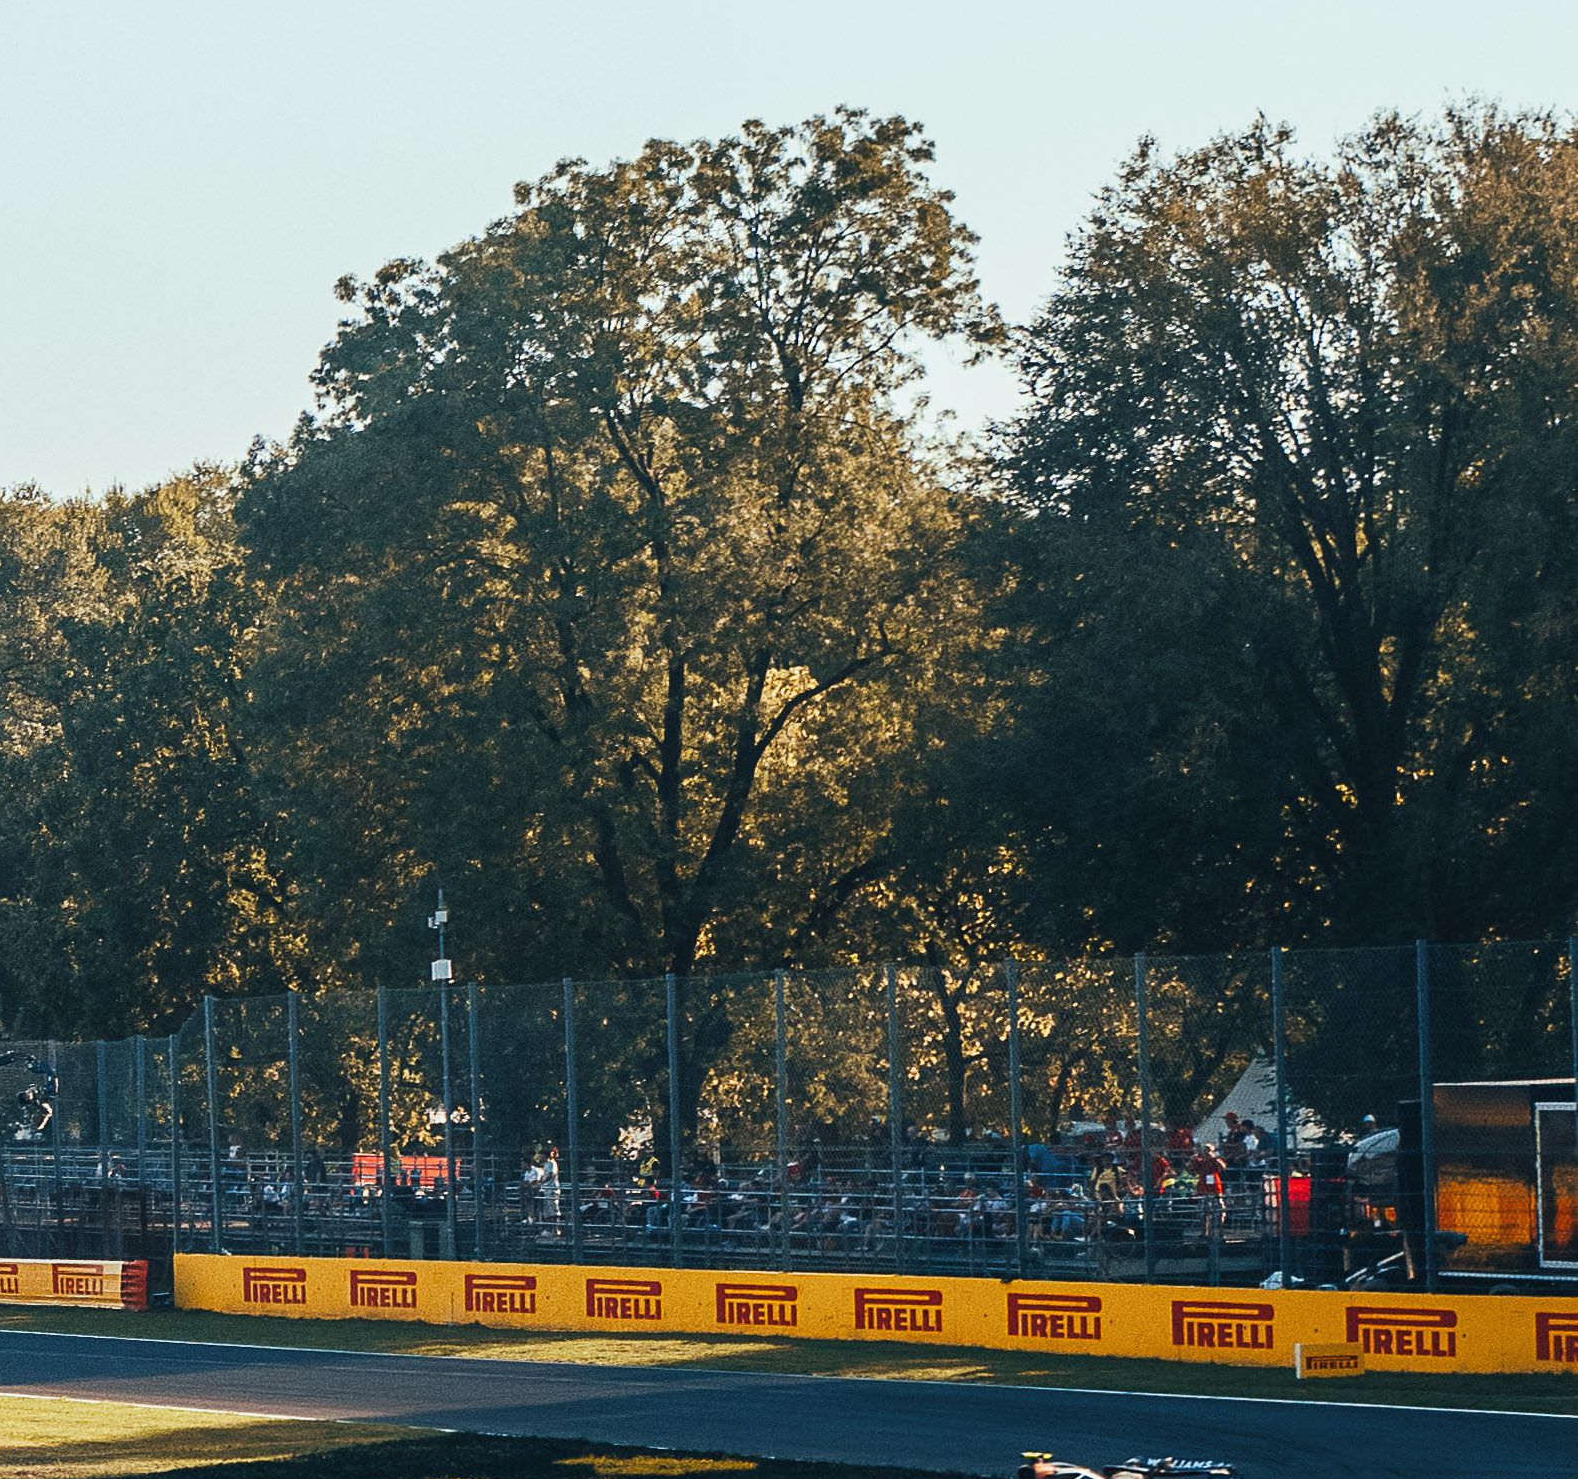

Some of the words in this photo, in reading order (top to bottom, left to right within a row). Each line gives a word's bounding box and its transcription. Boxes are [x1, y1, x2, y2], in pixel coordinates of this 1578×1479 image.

[52, 1264, 103, 1296] PIRELLI
[243, 1268, 306, 1304] PIRELLI
[350, 1270, 417, 1308] PIRELLI
[465, 1274, 536, 1314] PIRELLI
[586, 1279, 662, 1320] PIRELLI
[716, 1284, 797, 1326] PIRELLI
[855, 1288, 942, 1332] PIRELLI
[1007, 1293, 1102, 1340] PIRELLI
[1172, 1301, 1274, 1349] PIRELLI
[1346, 1306, 1457, 1357] PIRELLI
[1306, 1355, 1358, 1370] PIRELLI
